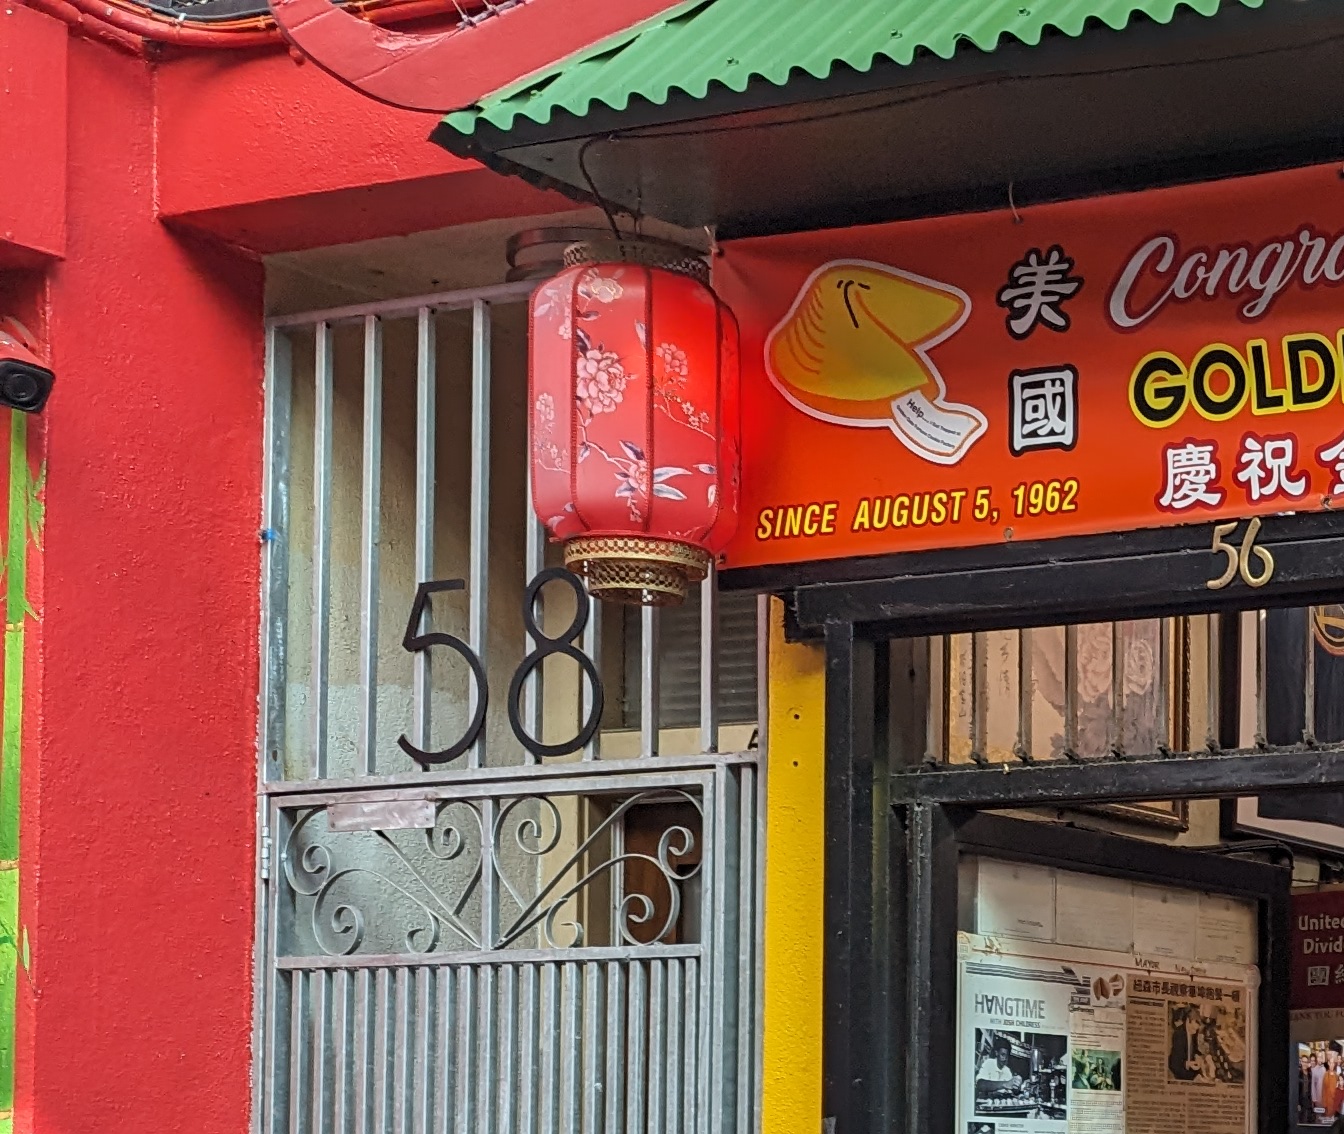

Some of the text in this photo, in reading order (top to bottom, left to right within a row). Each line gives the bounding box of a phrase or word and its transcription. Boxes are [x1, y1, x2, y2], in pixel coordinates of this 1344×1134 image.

[999, 248, 1081, 453] 美國
[757, 480, 1079, 540] SINCE AUGUST 5, 1962
[1206, 517, 1274, 590] 56
[397, 567, 604, 765] 58
